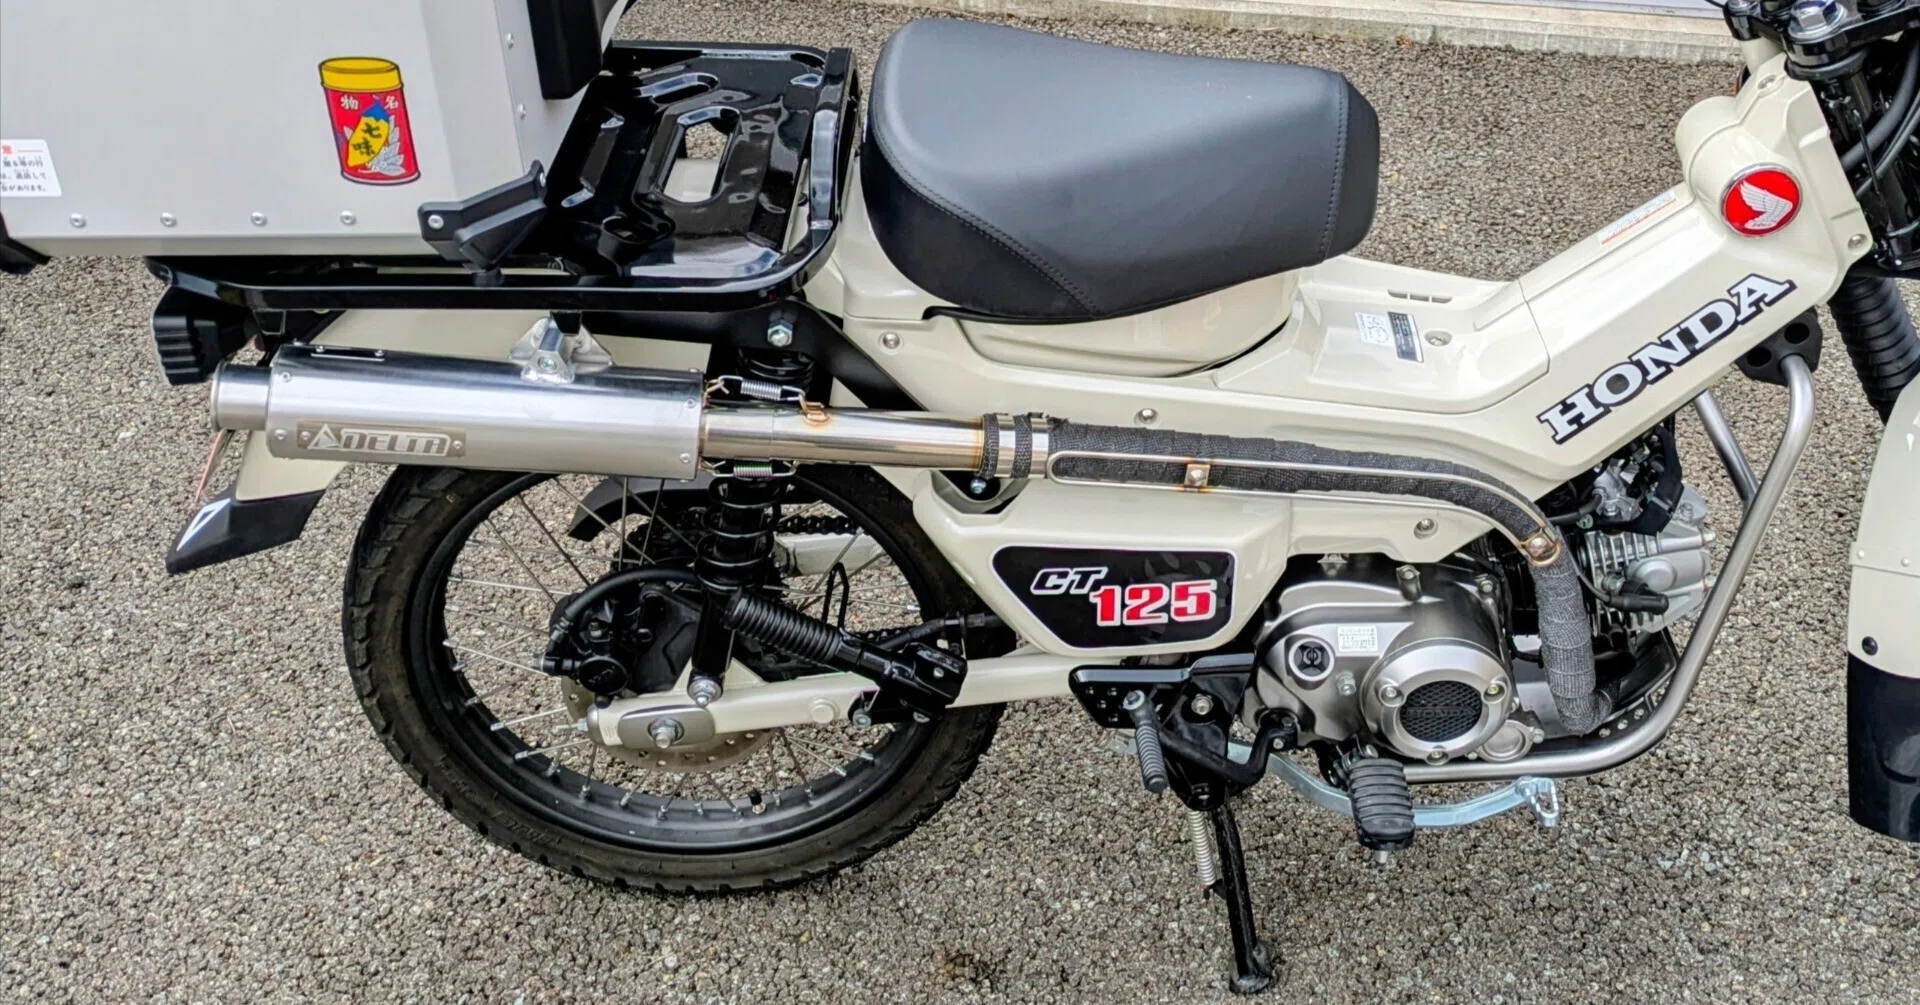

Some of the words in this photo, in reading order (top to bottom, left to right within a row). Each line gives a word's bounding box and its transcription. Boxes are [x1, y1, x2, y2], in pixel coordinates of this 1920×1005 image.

[340, 94, 359, 111] 物
[384, 94, 400, 110] 名
[351, 122, 383, 157] 七味
[1537, 273, 1796, 444] HONDA
[341, 429, 451, 457] DELTA
[1030, 567, 1108, 595] CT
[1089, 579, 1217, 626] 125
